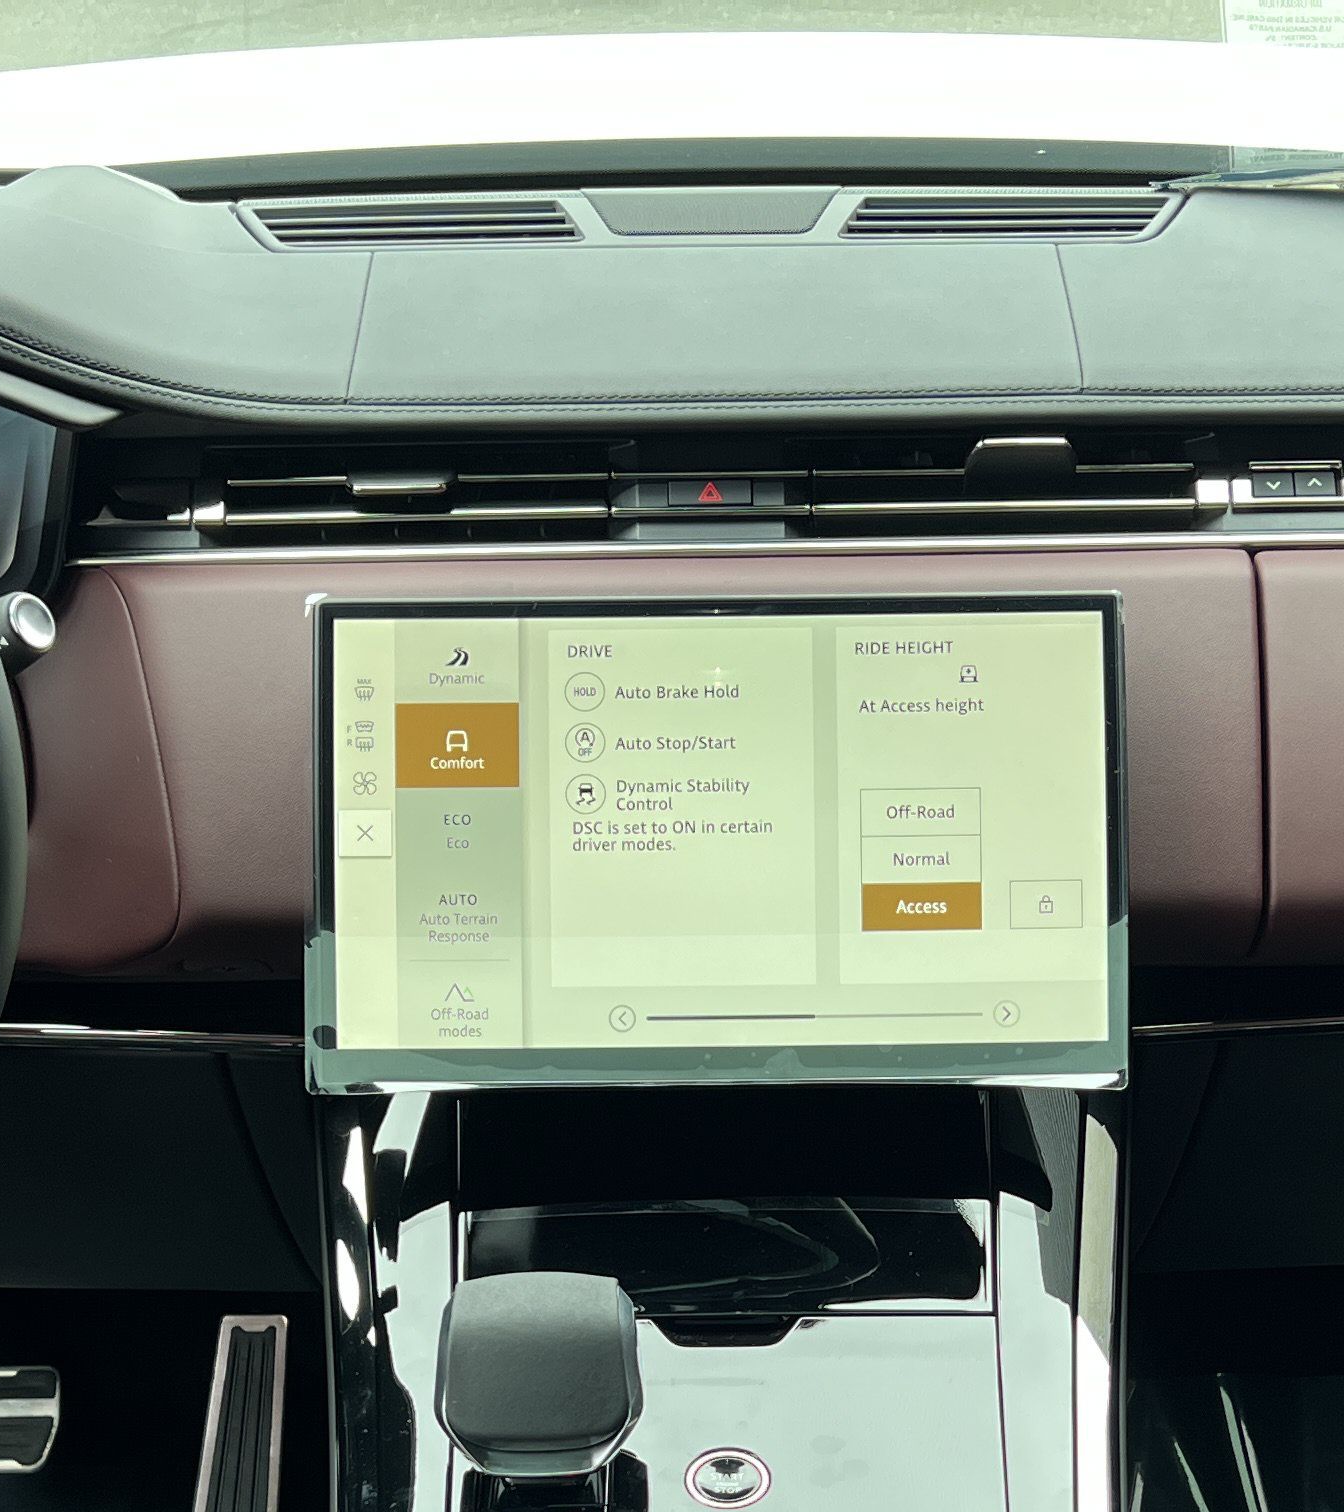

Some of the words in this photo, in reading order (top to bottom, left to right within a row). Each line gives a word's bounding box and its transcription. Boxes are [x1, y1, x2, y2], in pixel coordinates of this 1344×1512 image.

[567, 644, 613, 659] DRIVE
[855, 641, 891, 655] RIDE
[896, 640, 955, 655] HEIGHT
[428, 672, 485, 686] Dynamic
[573, 686, 598, 697] HOLD
[615, 685, 652, 700] Auto
[657, 684, 699, 699] Brake
[704, 684, 740, 699] Hold
[858, 700, 876, 713] At
[880, 699, 931, 713] Access
[935, 697, 985, 715] height
[615, 736, 652, 751] Auto
[656, 735, 737, 752] Stop/Start
[578, 747, 593, 757] OFF
[430, 755, 485, 770] Comfort
[616, 779, 683, 796] Dynamic
[687, 778, 751, 797] Stability
[616, 796, 674, 812] Control
[886, 805, 955, 820] Off-Road
[444, 814, 472, 827] ECO
[572, 820, 603, 836] DSC
[607, 820, 620, 835] is
[624, 820, 648, 835] set
[652, 820, 668, 835] to
[672, 820, 696, 835] ON
[701, 819, 715, 835] in
[720, 819, 774, 834] certain
[447, 837, 470, 849] Eco
[572, 837, 618, 852] driver
[622, 838, 677, 852] modes.
[892, 852, 951, 867] Normal
[439, 894, 478, 906] AUTO
[895, 899, 948, 915] Access
[420, 913, 449, 926] Auto
[453, 913, 498, 926] Terrain
[428, 929, 490, 944] Response
[431, 1007, 489, 1022] Off-Road
[438, 1025, 482, 1038] modes
